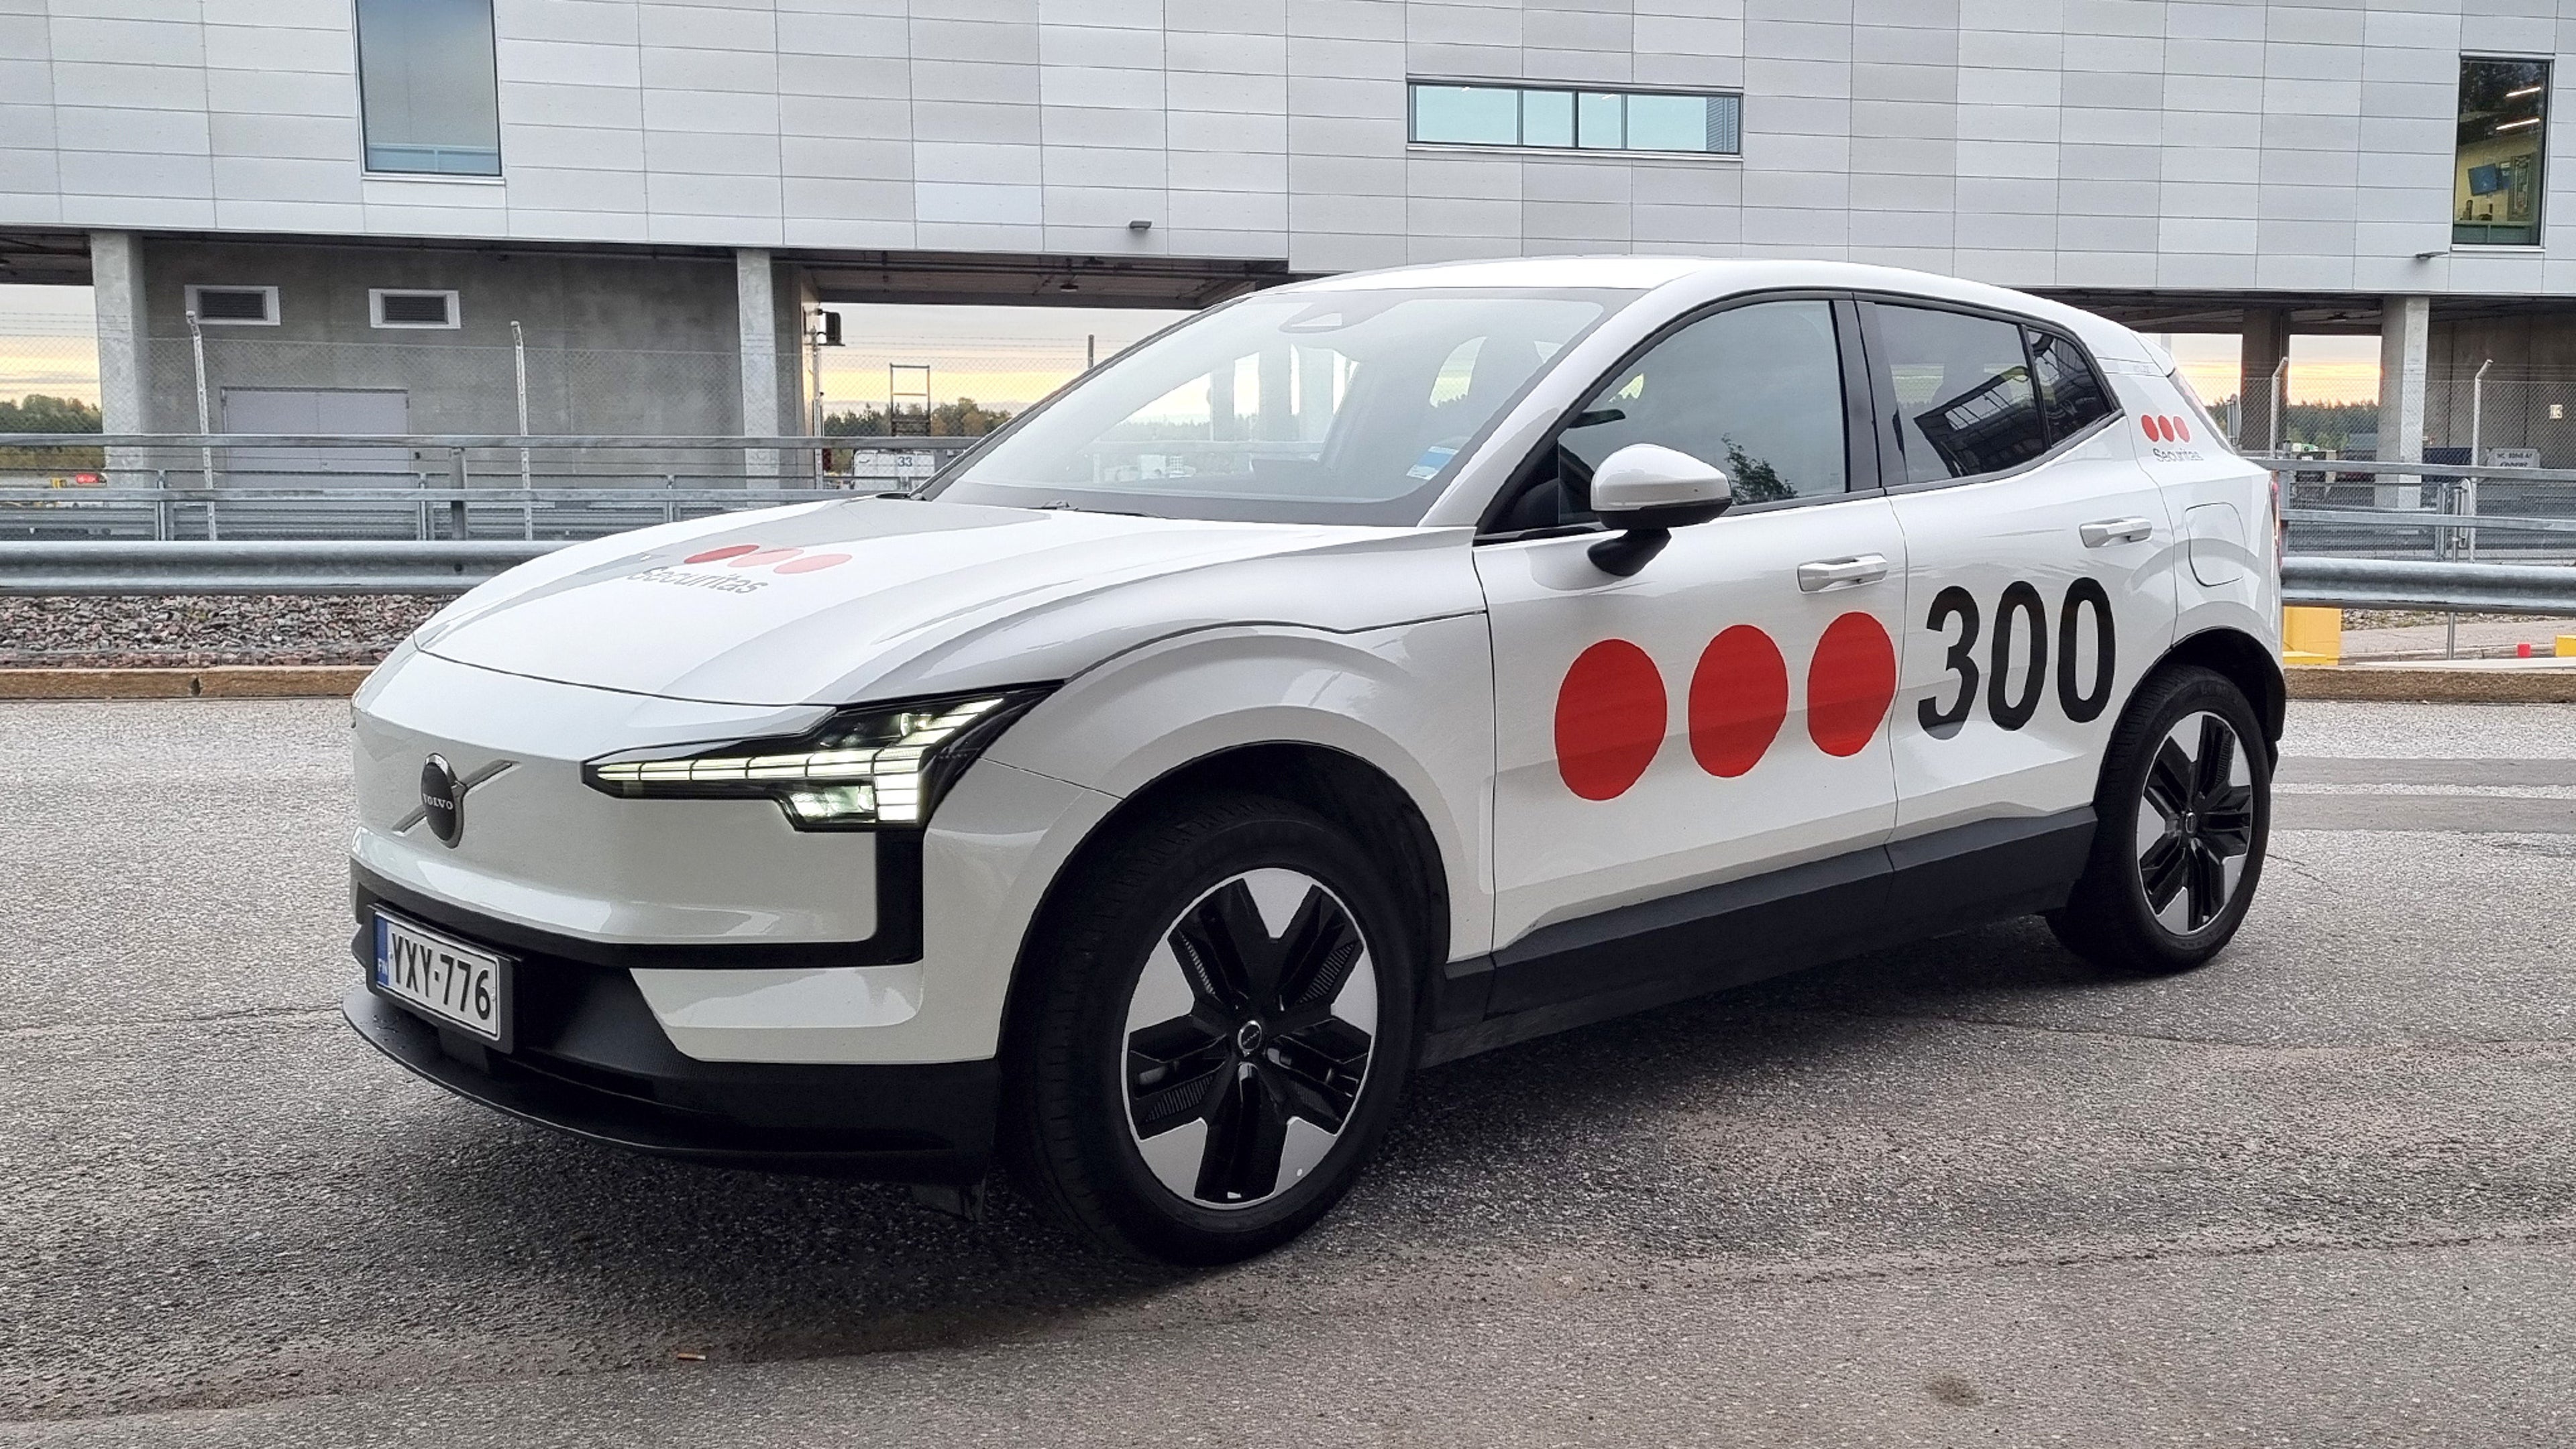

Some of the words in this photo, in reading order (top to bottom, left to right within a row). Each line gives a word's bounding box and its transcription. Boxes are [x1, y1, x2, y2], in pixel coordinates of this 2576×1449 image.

[898, 456, 912, 467] 33
[2153, 447, 2204, 462] Securitas
[627, 566, 768, 594] Securitas
[1918, 577, 2116, 740] 300
[422, 793, 453, 810] VOLVO
[392, 932, 490, 1020] YXY-776
